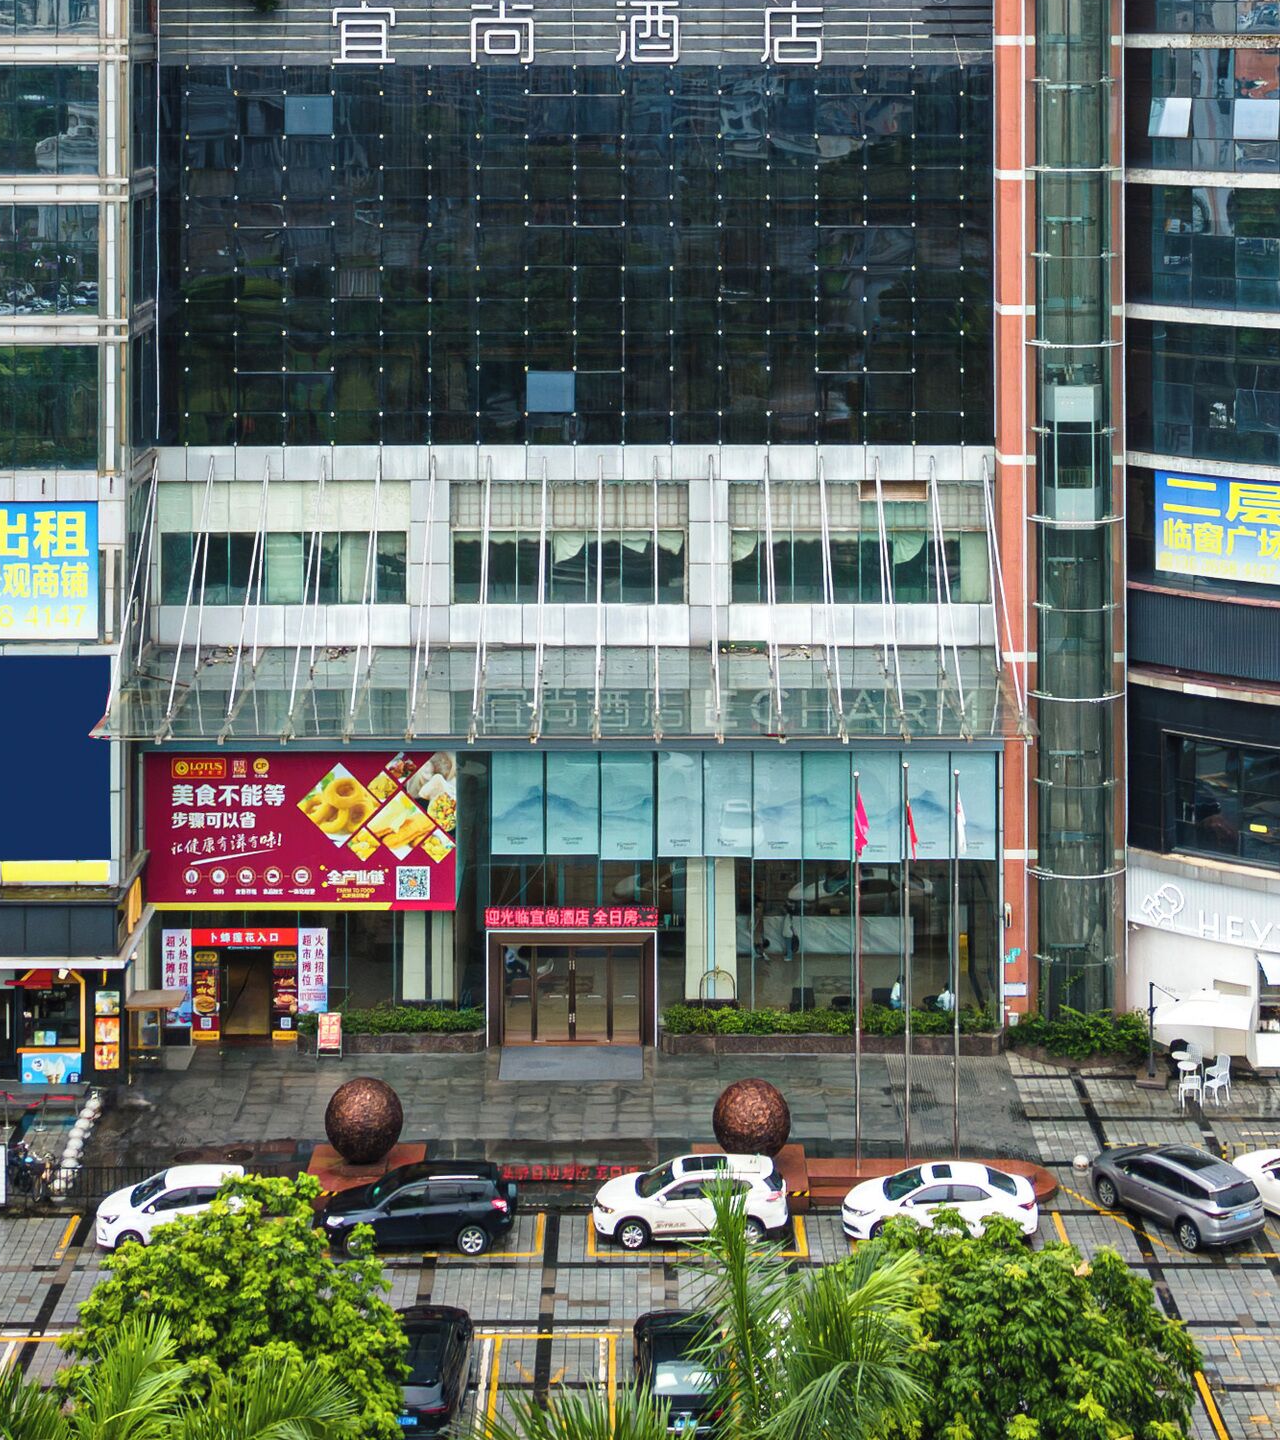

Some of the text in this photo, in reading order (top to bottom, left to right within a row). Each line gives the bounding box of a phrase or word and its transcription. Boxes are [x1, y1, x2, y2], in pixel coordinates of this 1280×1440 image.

[331, 0, 823, 65] 宜尚酒店
[23, 604, 88, 629] 4147
[171, 784, 286, 807] 美食不能等
[171, 811, 257, 829] 步骤可以省
[326, 869, 385, 885] 全产业链
[210, 932, 279, 943] 卜蜂莲花入口
[165, 935, 176, 987] 超市摊位
[178, 935, 189, 987] 火热招商
[302, 934, 312, 986] 超市摊位
[315, 934, 325, 986] 火热招商
